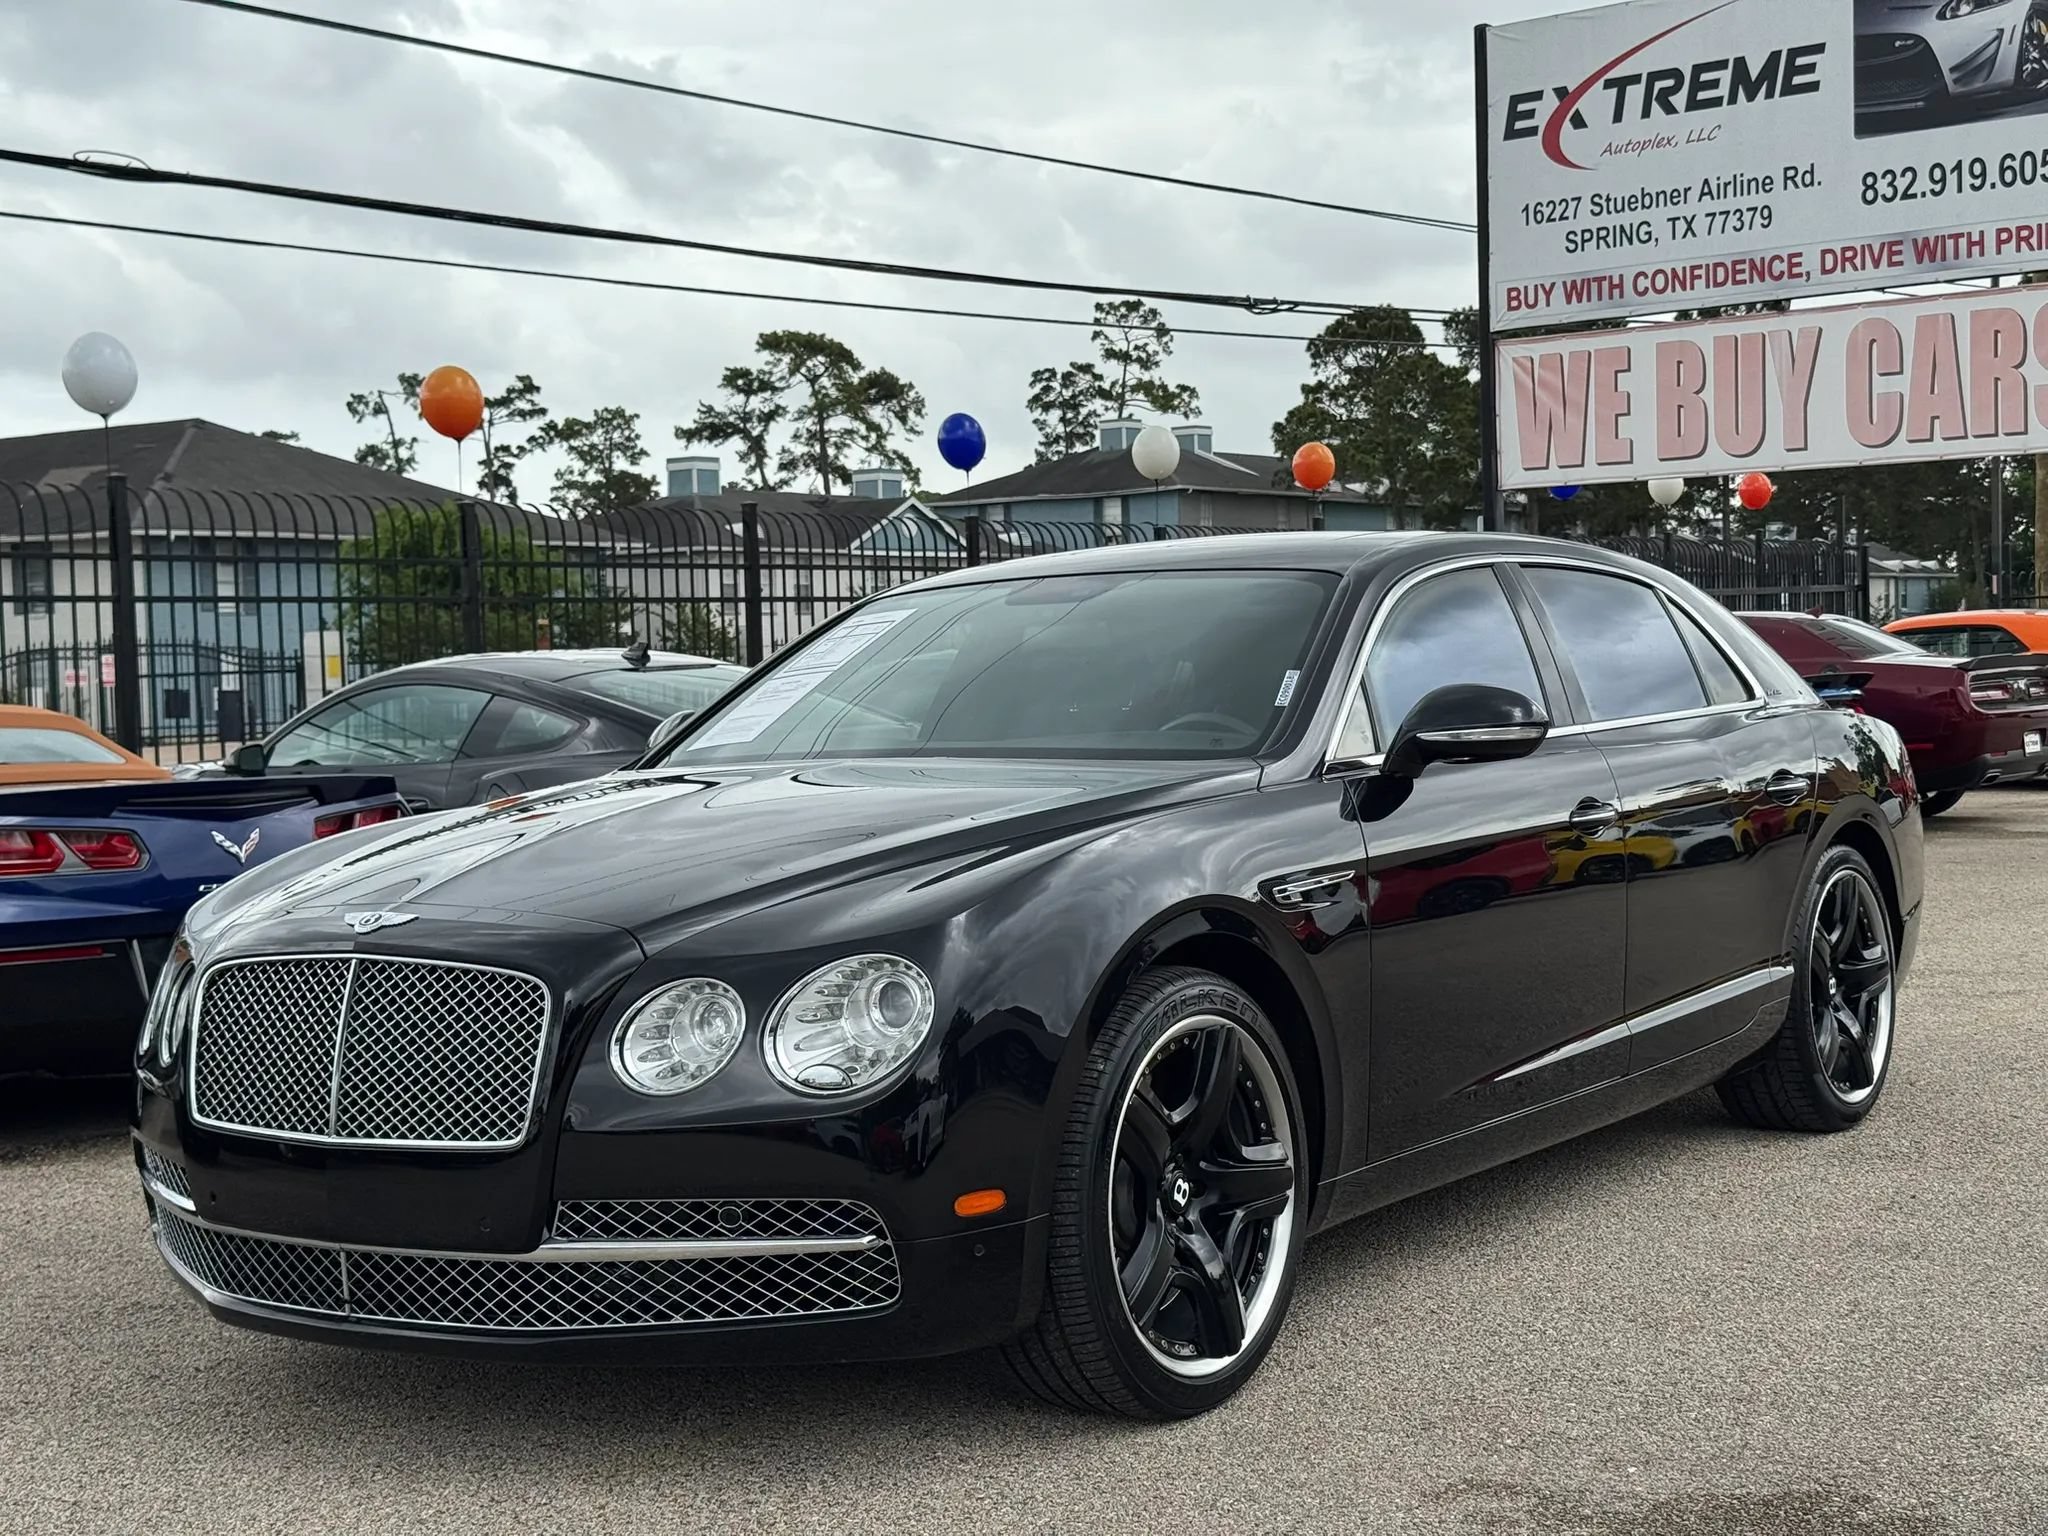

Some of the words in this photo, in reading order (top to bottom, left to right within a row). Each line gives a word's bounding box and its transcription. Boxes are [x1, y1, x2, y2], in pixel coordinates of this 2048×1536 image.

[1503, 42, 1826, 142] EXTREME
[1600, 132, 1679, 158] Autoplex,
[1685, 124, 1722, 145] LLC
[1520, 196, 1583, 227] 16227
[1589, 184, 1692, 217] Stuebner
[1697, 172, 1775, 203] Airline
[1782, 162, 1822, 192] Rd.
[1564, 220, 1660, 254] SPRING,
[1667, 214, 1697, 241] TX
[1705, 205, 1773, 237] 77379
[1506, 282, 1556, 312] BUY
[1562, 274, 1625, 306] WITH
[1632, 252, 1811, 297] CONFIDENCE,
[1820, 240, 1905, 276] DRIVE
[1912, 230, 1985, 265] WITH
[1995, 223, 2048, 256] PRI
[1512, 345, 1634, 471] WE
[1656, 325, 1823, 462] BUY
[1845, 303, 2048, 449] CAR
